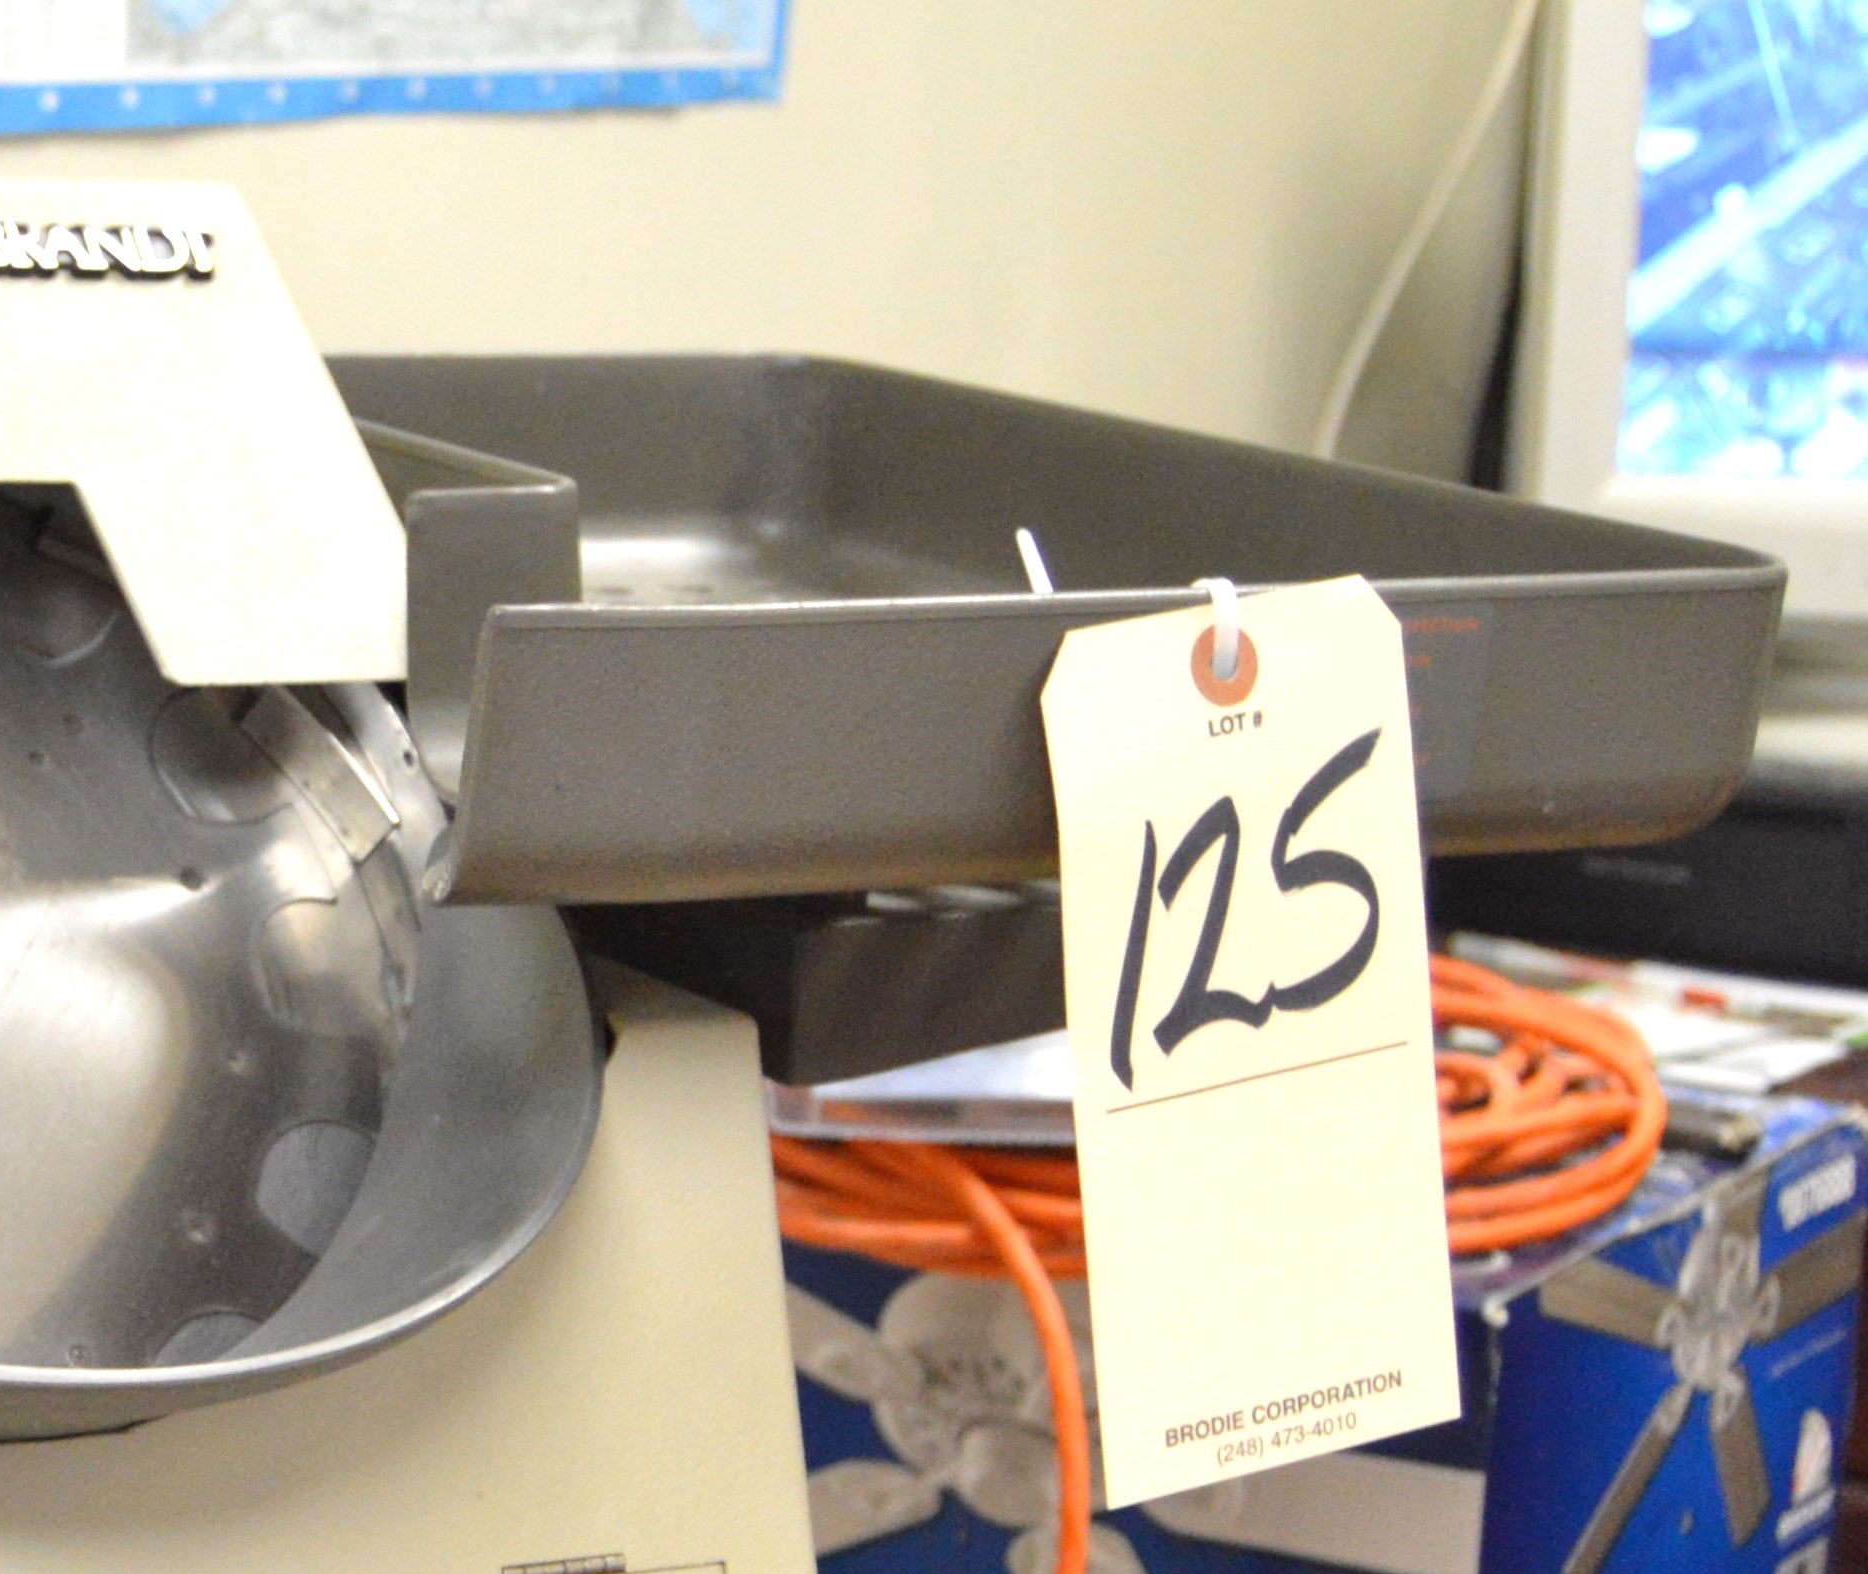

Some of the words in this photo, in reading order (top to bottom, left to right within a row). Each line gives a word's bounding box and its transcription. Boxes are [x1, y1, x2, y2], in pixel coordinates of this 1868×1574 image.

[1208, 714, 1246, 738] LOT
[1252, 710, 1264, 728] #
[1110, 726, 1384, 1093] 125
[1165, 1411, 1245, 1448] BRODIE
[1251, 1369, 1403, 1425] CORPORATION
[1217, 1436, 1265, 1468] (248)
[1271, 1411, 1357, 1449] 473-4010
